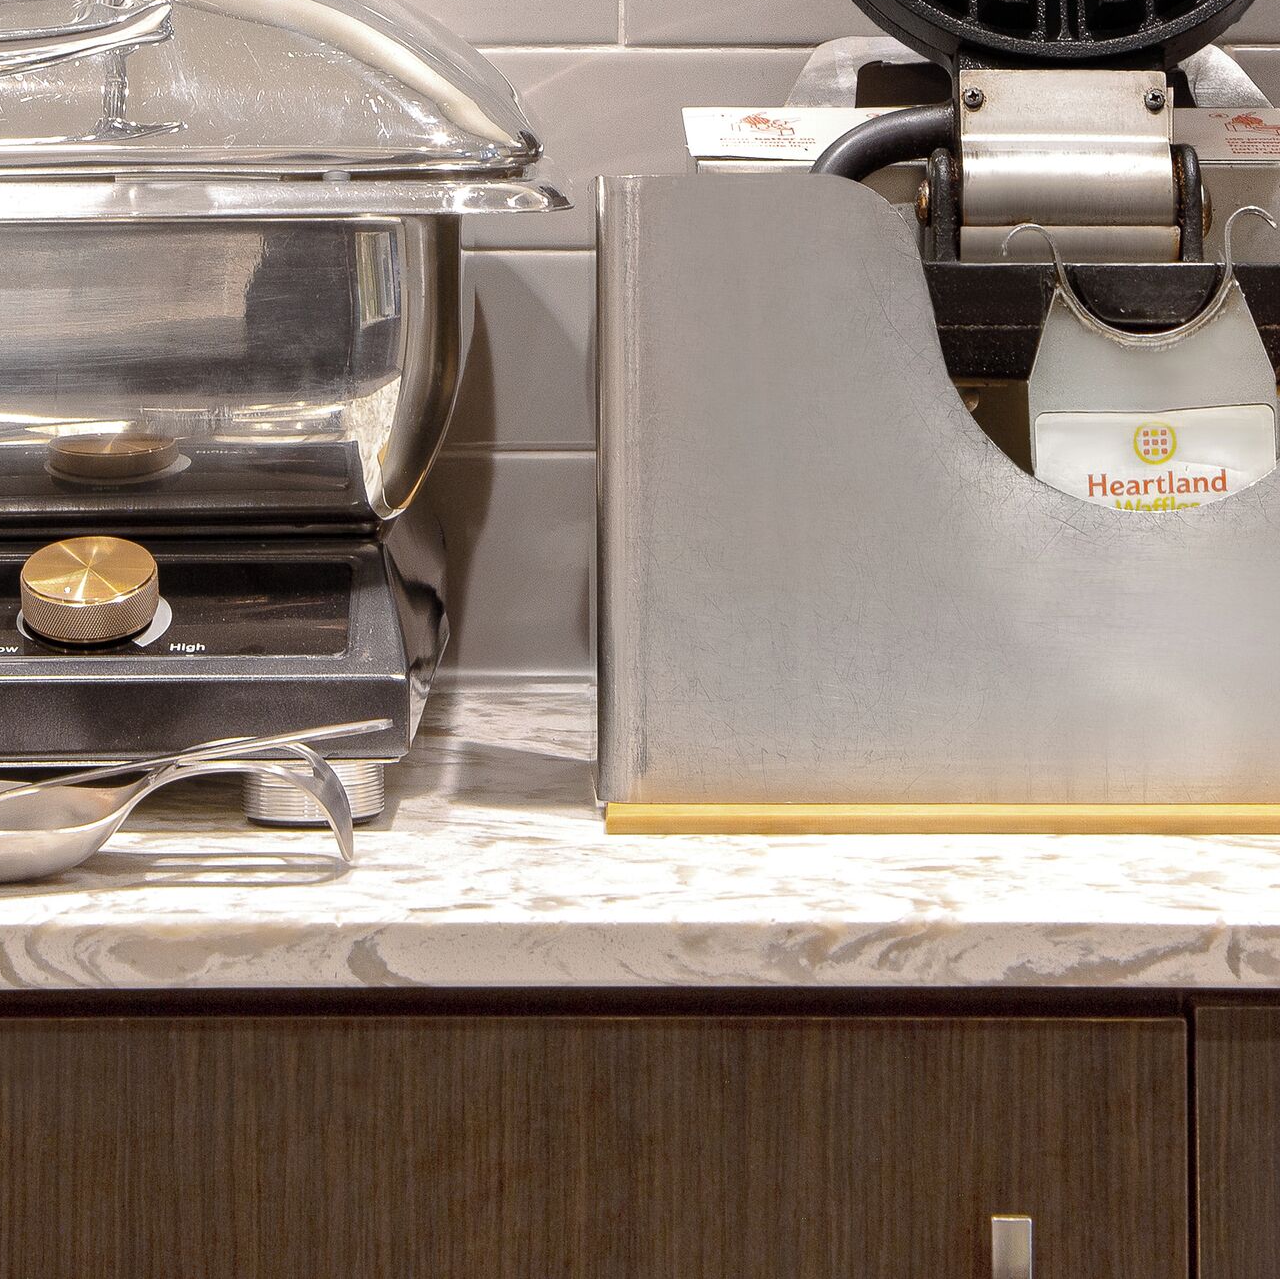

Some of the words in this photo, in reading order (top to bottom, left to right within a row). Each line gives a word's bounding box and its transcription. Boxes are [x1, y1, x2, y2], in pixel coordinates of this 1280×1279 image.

[1088, 468, 1229, 497] Heartland
[1115, 496, 1200, 512] Waffl
[170, 642, 205, 653] High
